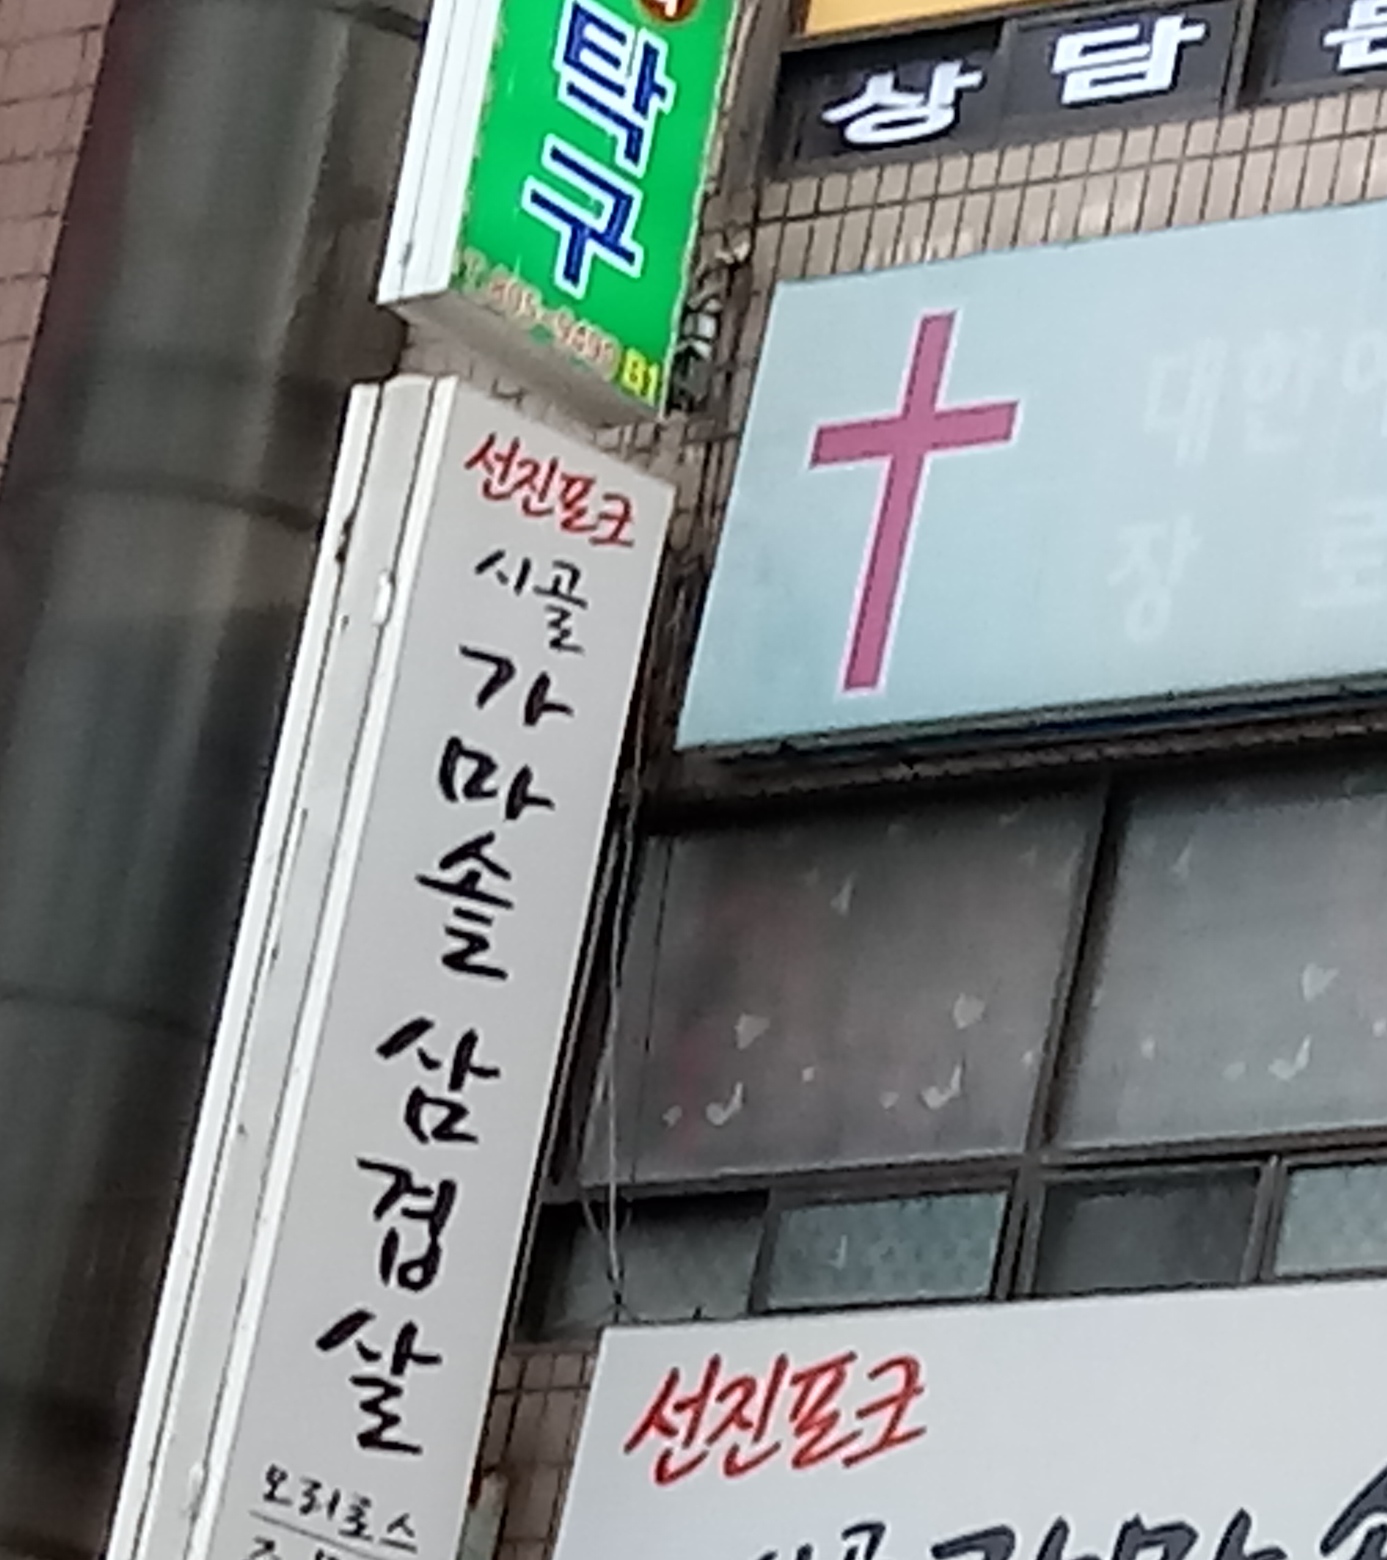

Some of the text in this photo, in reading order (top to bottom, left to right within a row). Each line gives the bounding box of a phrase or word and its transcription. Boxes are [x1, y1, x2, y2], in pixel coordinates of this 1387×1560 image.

[521, 0, 678, 300] 탁구
[465, 431, 636, 548] 선진포크
[474, 548, 588, 656] 시골
[316, 1017, 502, 1456] 삼겹살
[622, 1350, 928, 1487] 선진포크
